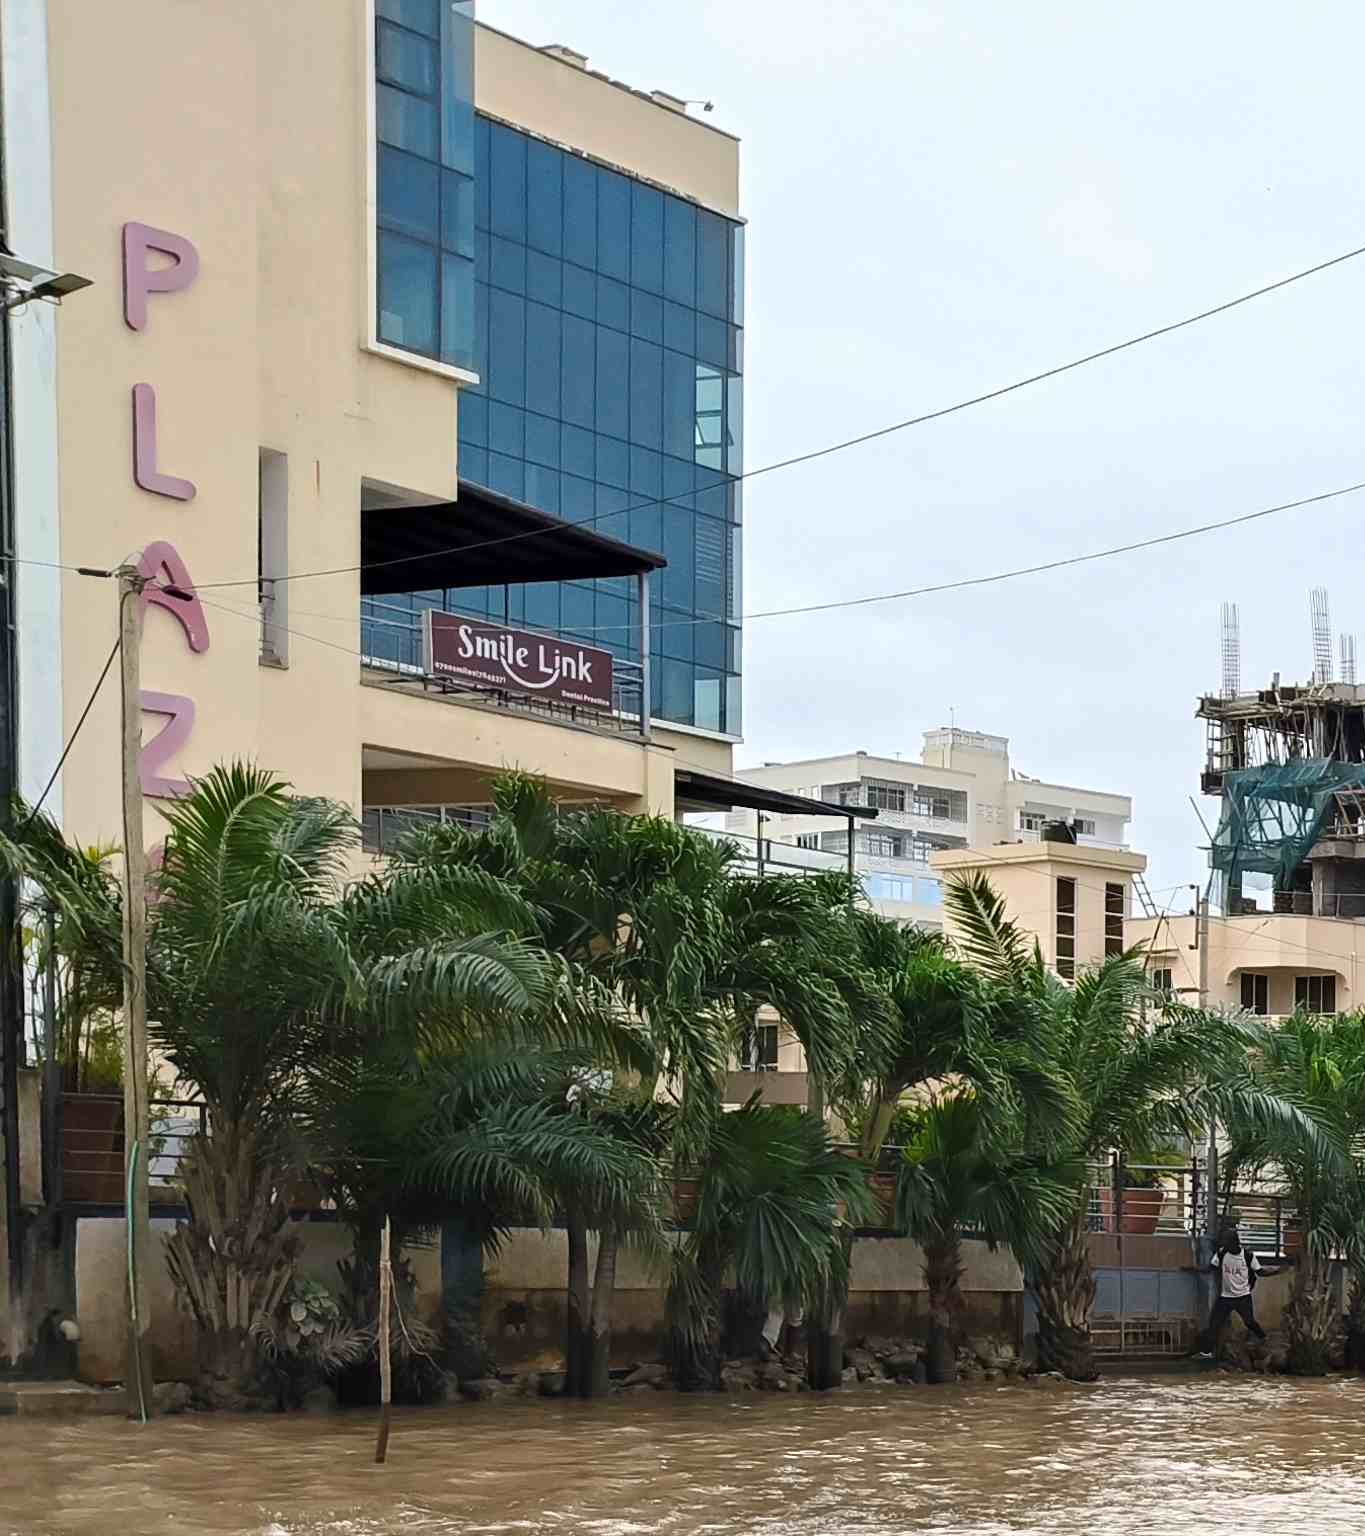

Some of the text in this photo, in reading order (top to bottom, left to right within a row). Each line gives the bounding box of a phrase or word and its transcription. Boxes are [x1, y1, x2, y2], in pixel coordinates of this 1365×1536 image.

[121, 222, 209, 905] PLAZ
[458, 624, 593, 684] Smile Link
